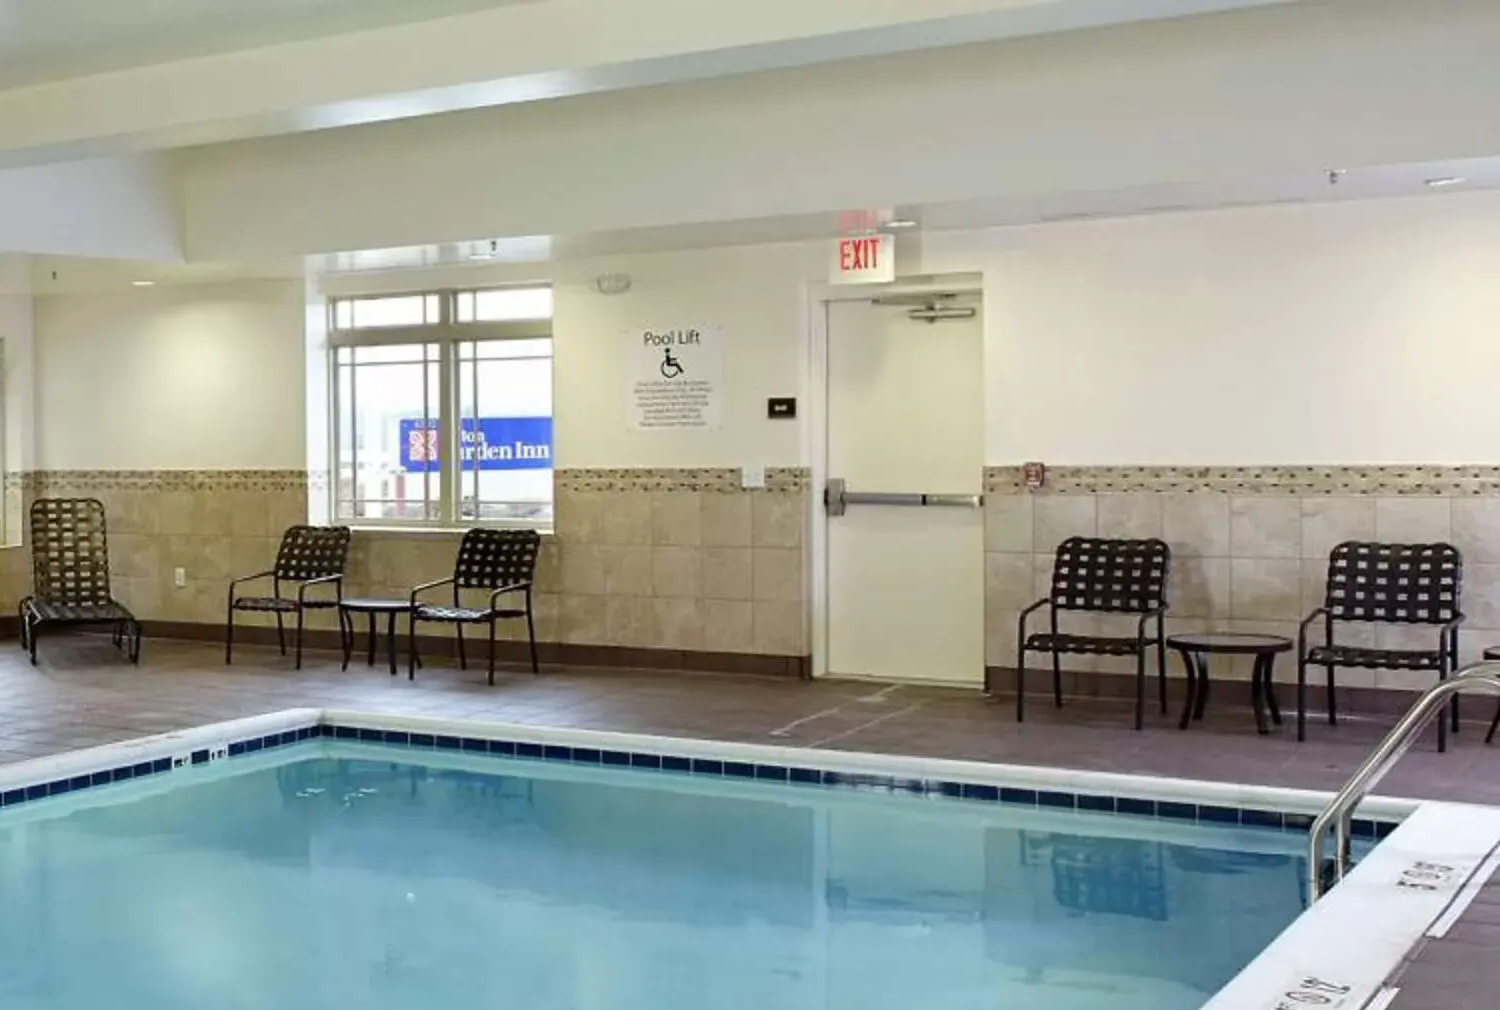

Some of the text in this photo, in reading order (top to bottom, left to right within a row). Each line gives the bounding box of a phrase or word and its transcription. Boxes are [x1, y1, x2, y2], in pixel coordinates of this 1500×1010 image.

[840, 239, 879, 270] EXIT
[644, 329, 701, 346] Pool Lift
[460, 441, 549, 460] rden Inn
